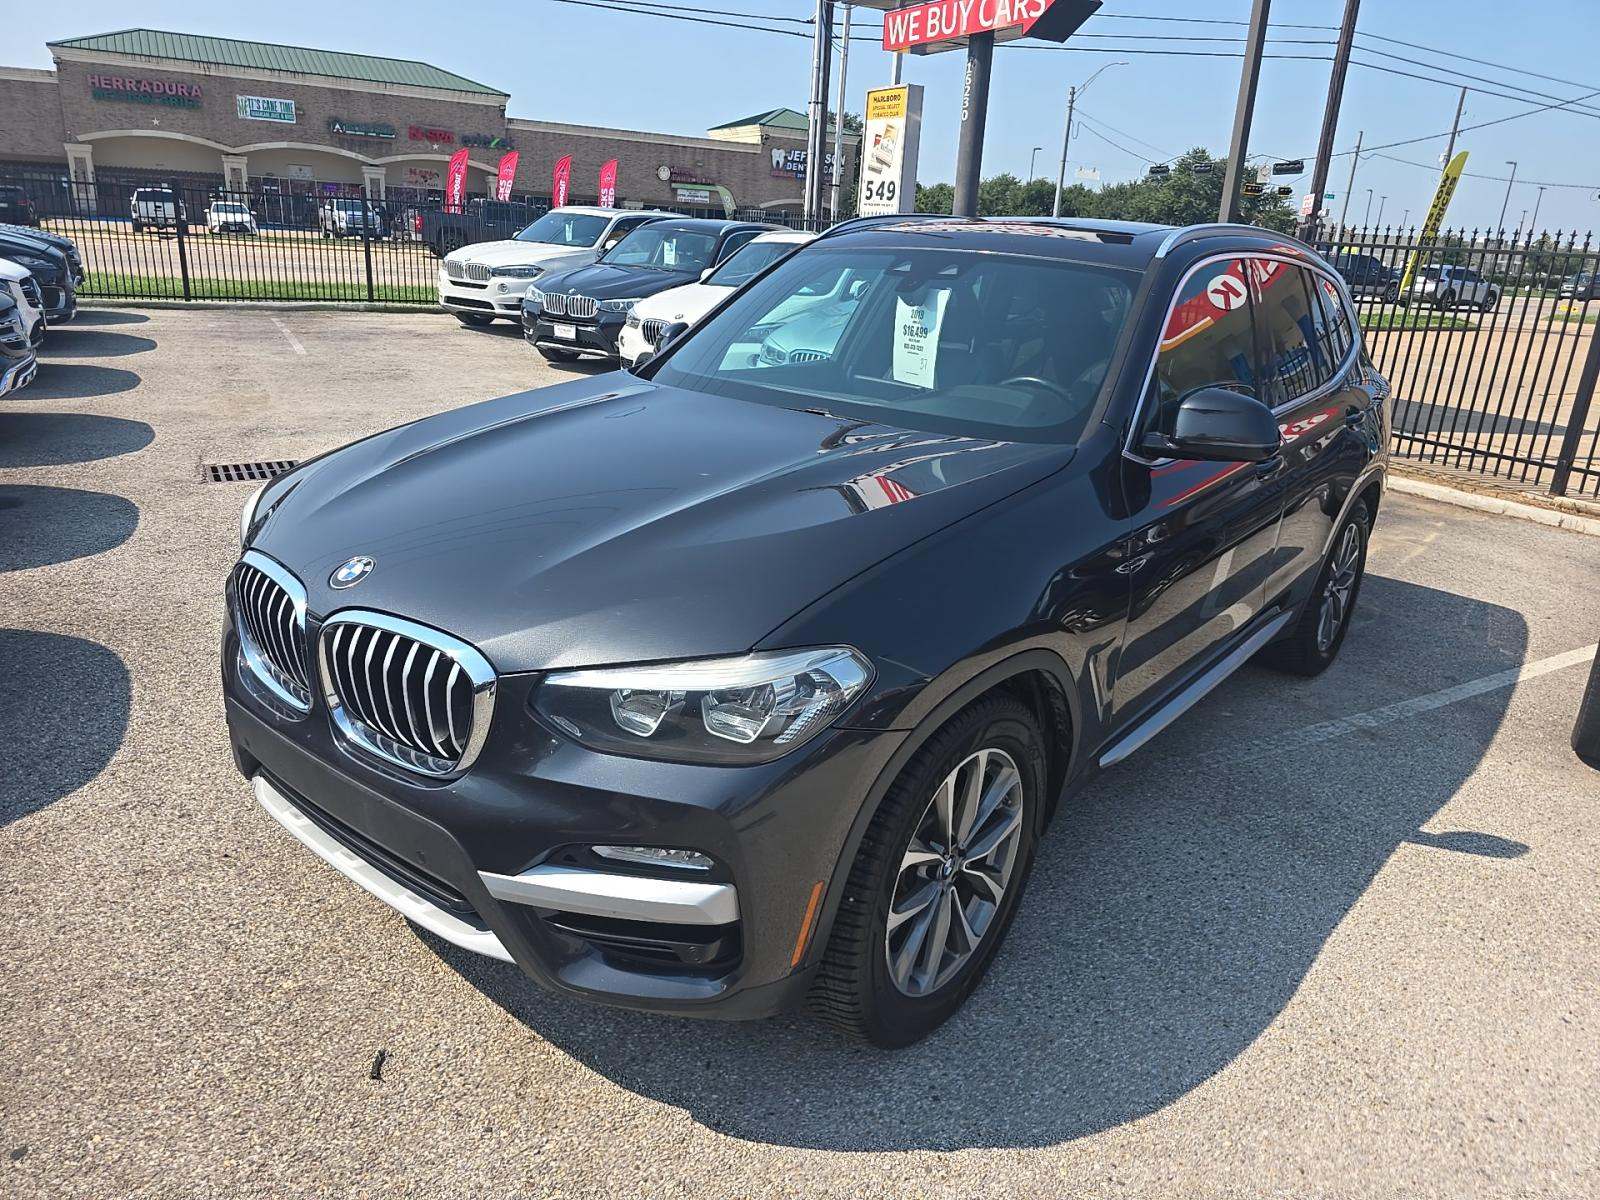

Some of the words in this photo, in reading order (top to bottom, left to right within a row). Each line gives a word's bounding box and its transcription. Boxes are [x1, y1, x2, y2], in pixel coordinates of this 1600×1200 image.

[888, 11, 921, 45] WE
[926, 0, 970, 38] BUY
[978, 0, 1046, 28] CARS
[87, 74, 202, 97] HERRADURA
[873, 94, 901, 103] MARLBORO
[865, 180, 896, 201] 549
[1429, 176, 1457, 232] PRICES
